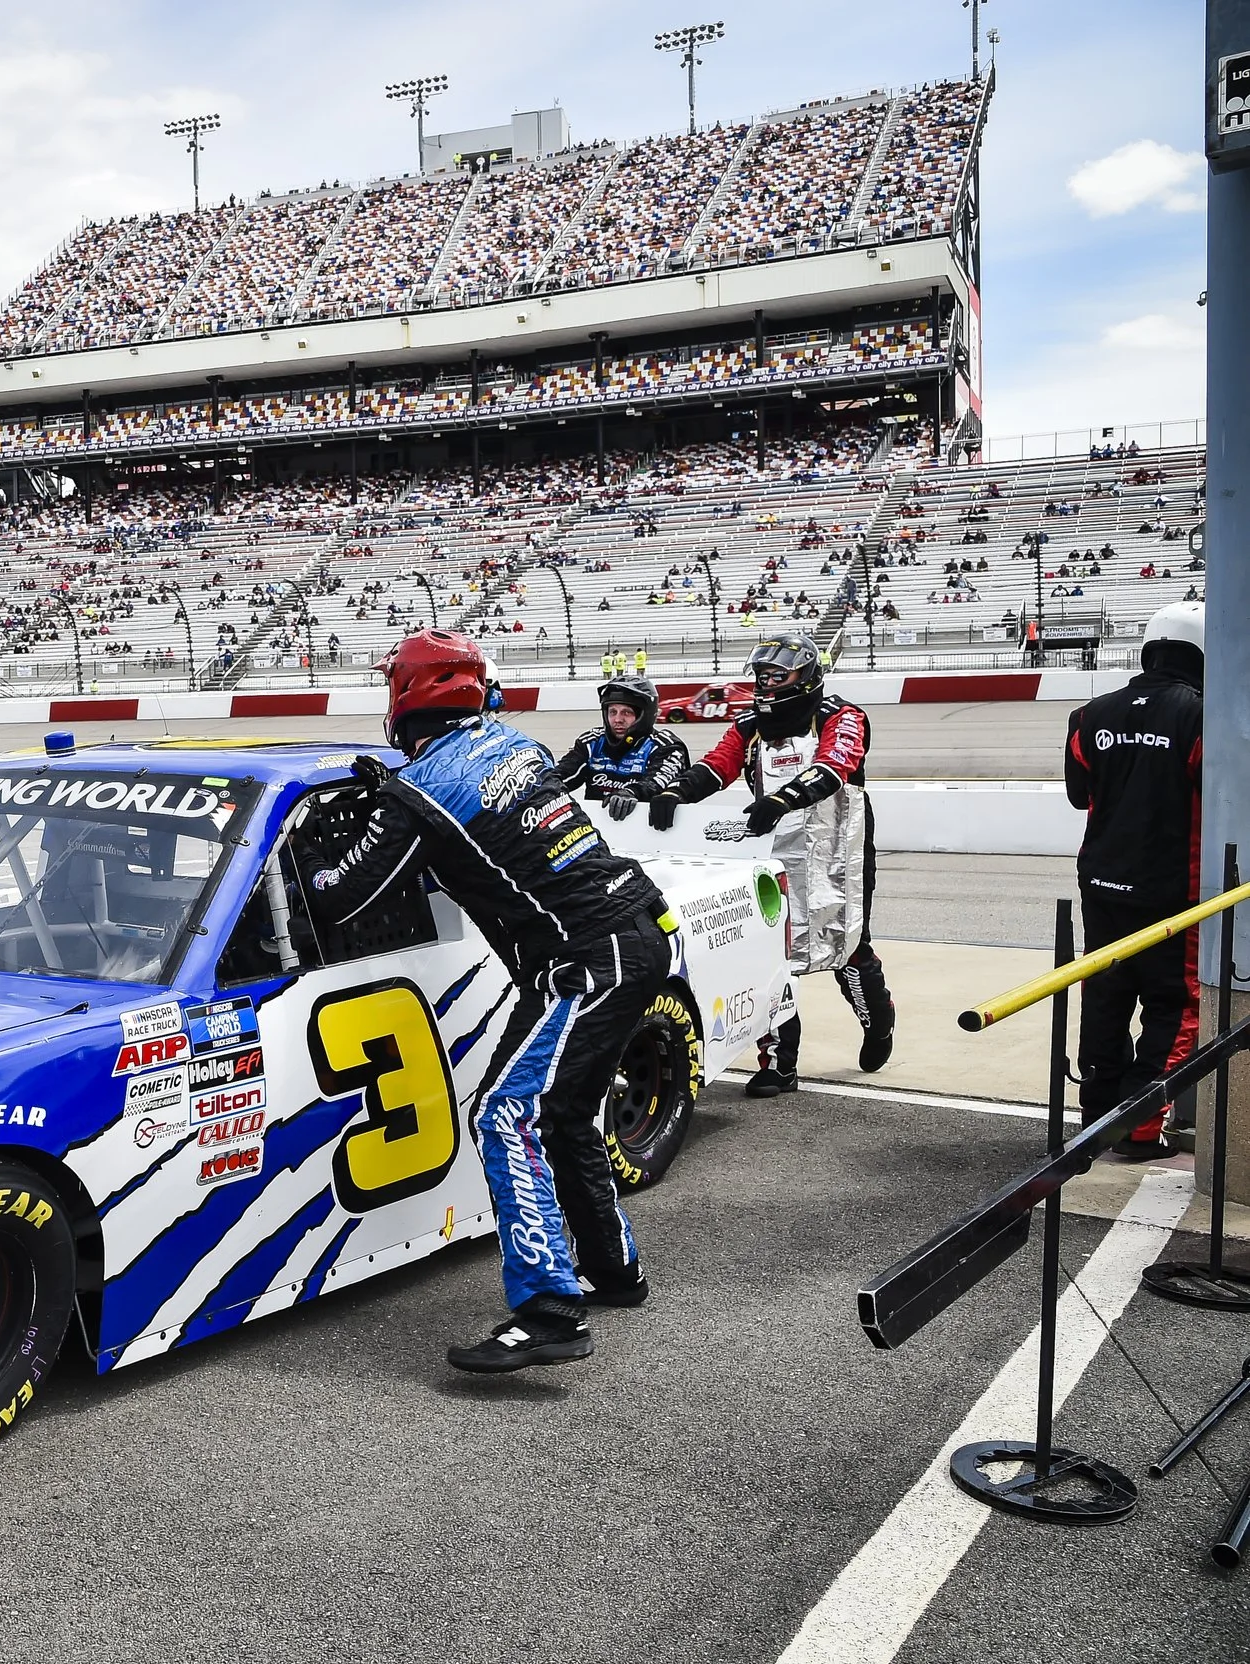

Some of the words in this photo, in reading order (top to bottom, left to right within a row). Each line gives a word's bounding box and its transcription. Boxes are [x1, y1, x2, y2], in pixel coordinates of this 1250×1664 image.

[703, 703, 728, 718] 04
[772, 754, 802, 766] SIMPSON
[47, 780, 218, 819] WORLD
[680, 897, 721, 919] PLUMBING,
[721, 886, 752, 905] HEATING,
[691, 920, 705, 936] AIR
[705, 903, 753, 931] CONDITIONING
[708, 936, 714, 950] &
[714, 924, 744, 948] ELECTRIC
[140, 1006, 173, 1024] NASCAR
[206, 1012, 239, 1027] CAMPING
[726, 988, 754, 1028] KEES
[128, 1024, 149, 1038] RACE
[151, 1018, 178, 1032] TRUCK
[208, 1022, 241, 1039] WORLD
[116, 1036, 188, 1070] ARP
[130, 1072, 182, 1098] COMETIC
[189, 1059, 234, 1085] Holley
[196, 1090, 261, 1118] tilton
[314, 983, 456, 1198] 3
[199, 1112, 264, 1146] CALICO
[201, 1147, 260, 1178] KOOKS
[606, 1130, 642, 1184] EAGLE
[494, 1096, 556, 1272] Bommarito
